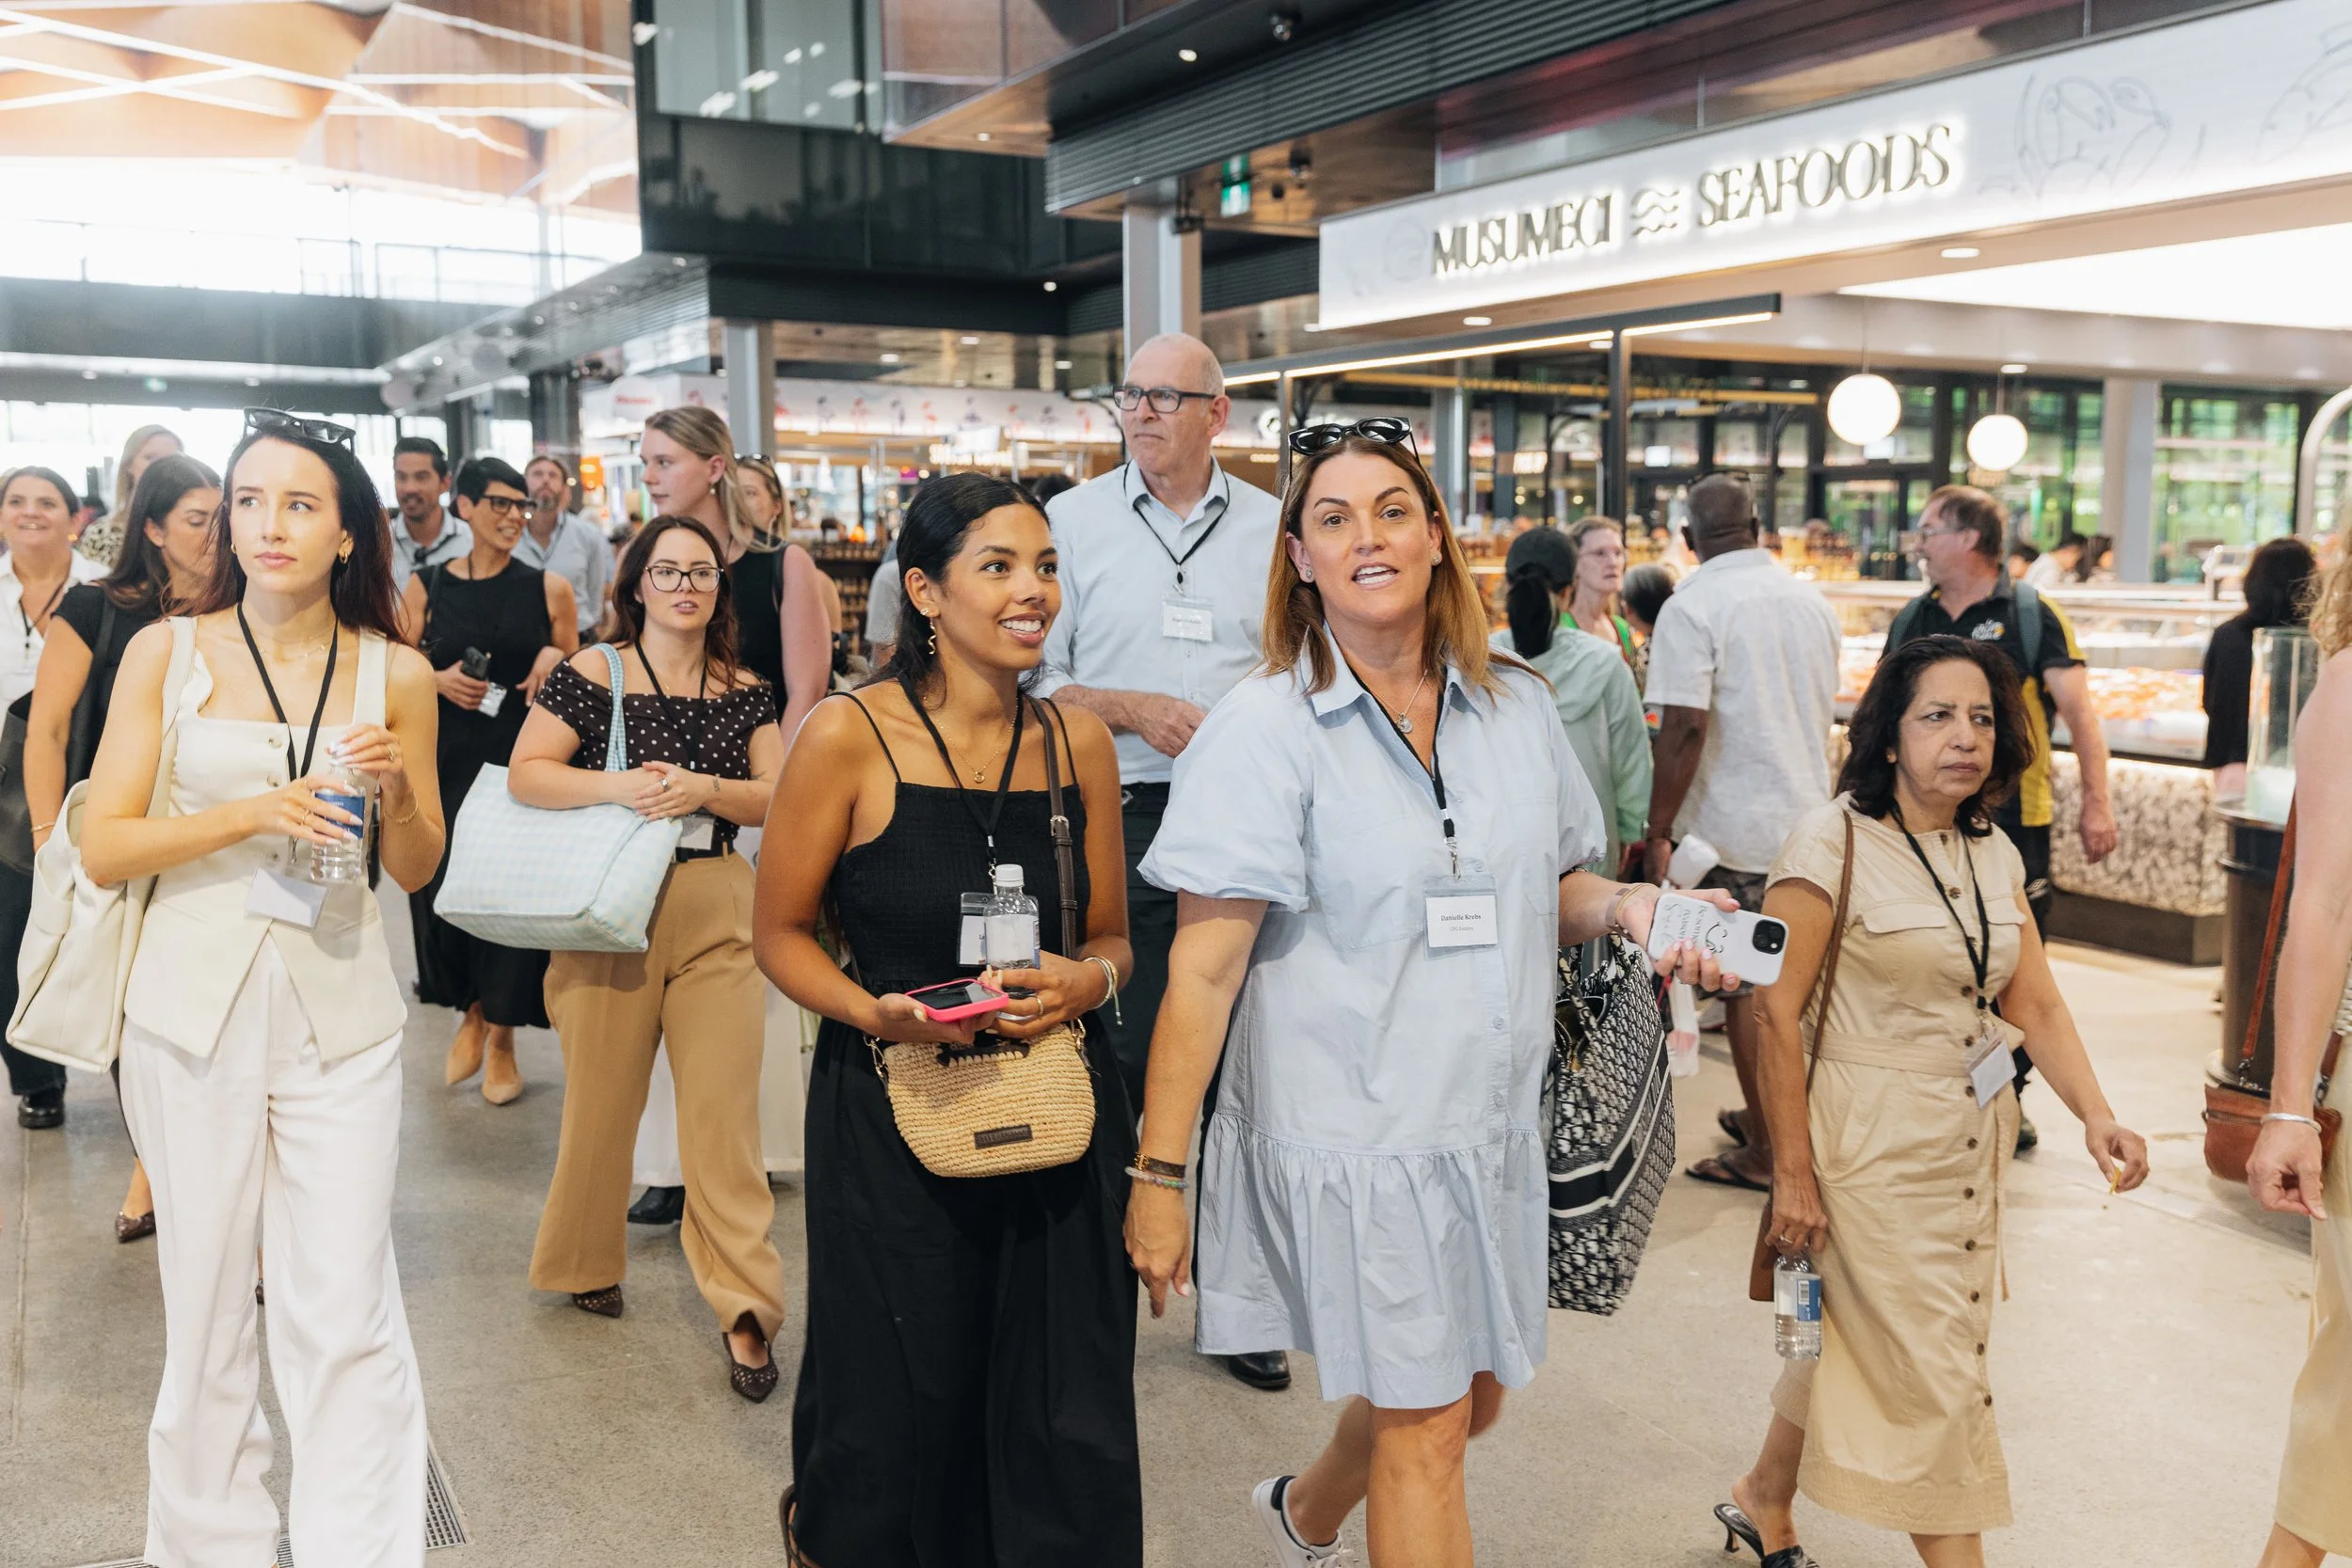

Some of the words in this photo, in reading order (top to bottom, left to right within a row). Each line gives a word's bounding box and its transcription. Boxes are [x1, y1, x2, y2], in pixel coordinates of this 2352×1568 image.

[1432, 196, 1613, 276] MUSUMECI
[1698, 123, 1950, 229] SEAFOODS
[1440, 913, 1464, 922] Danielle
